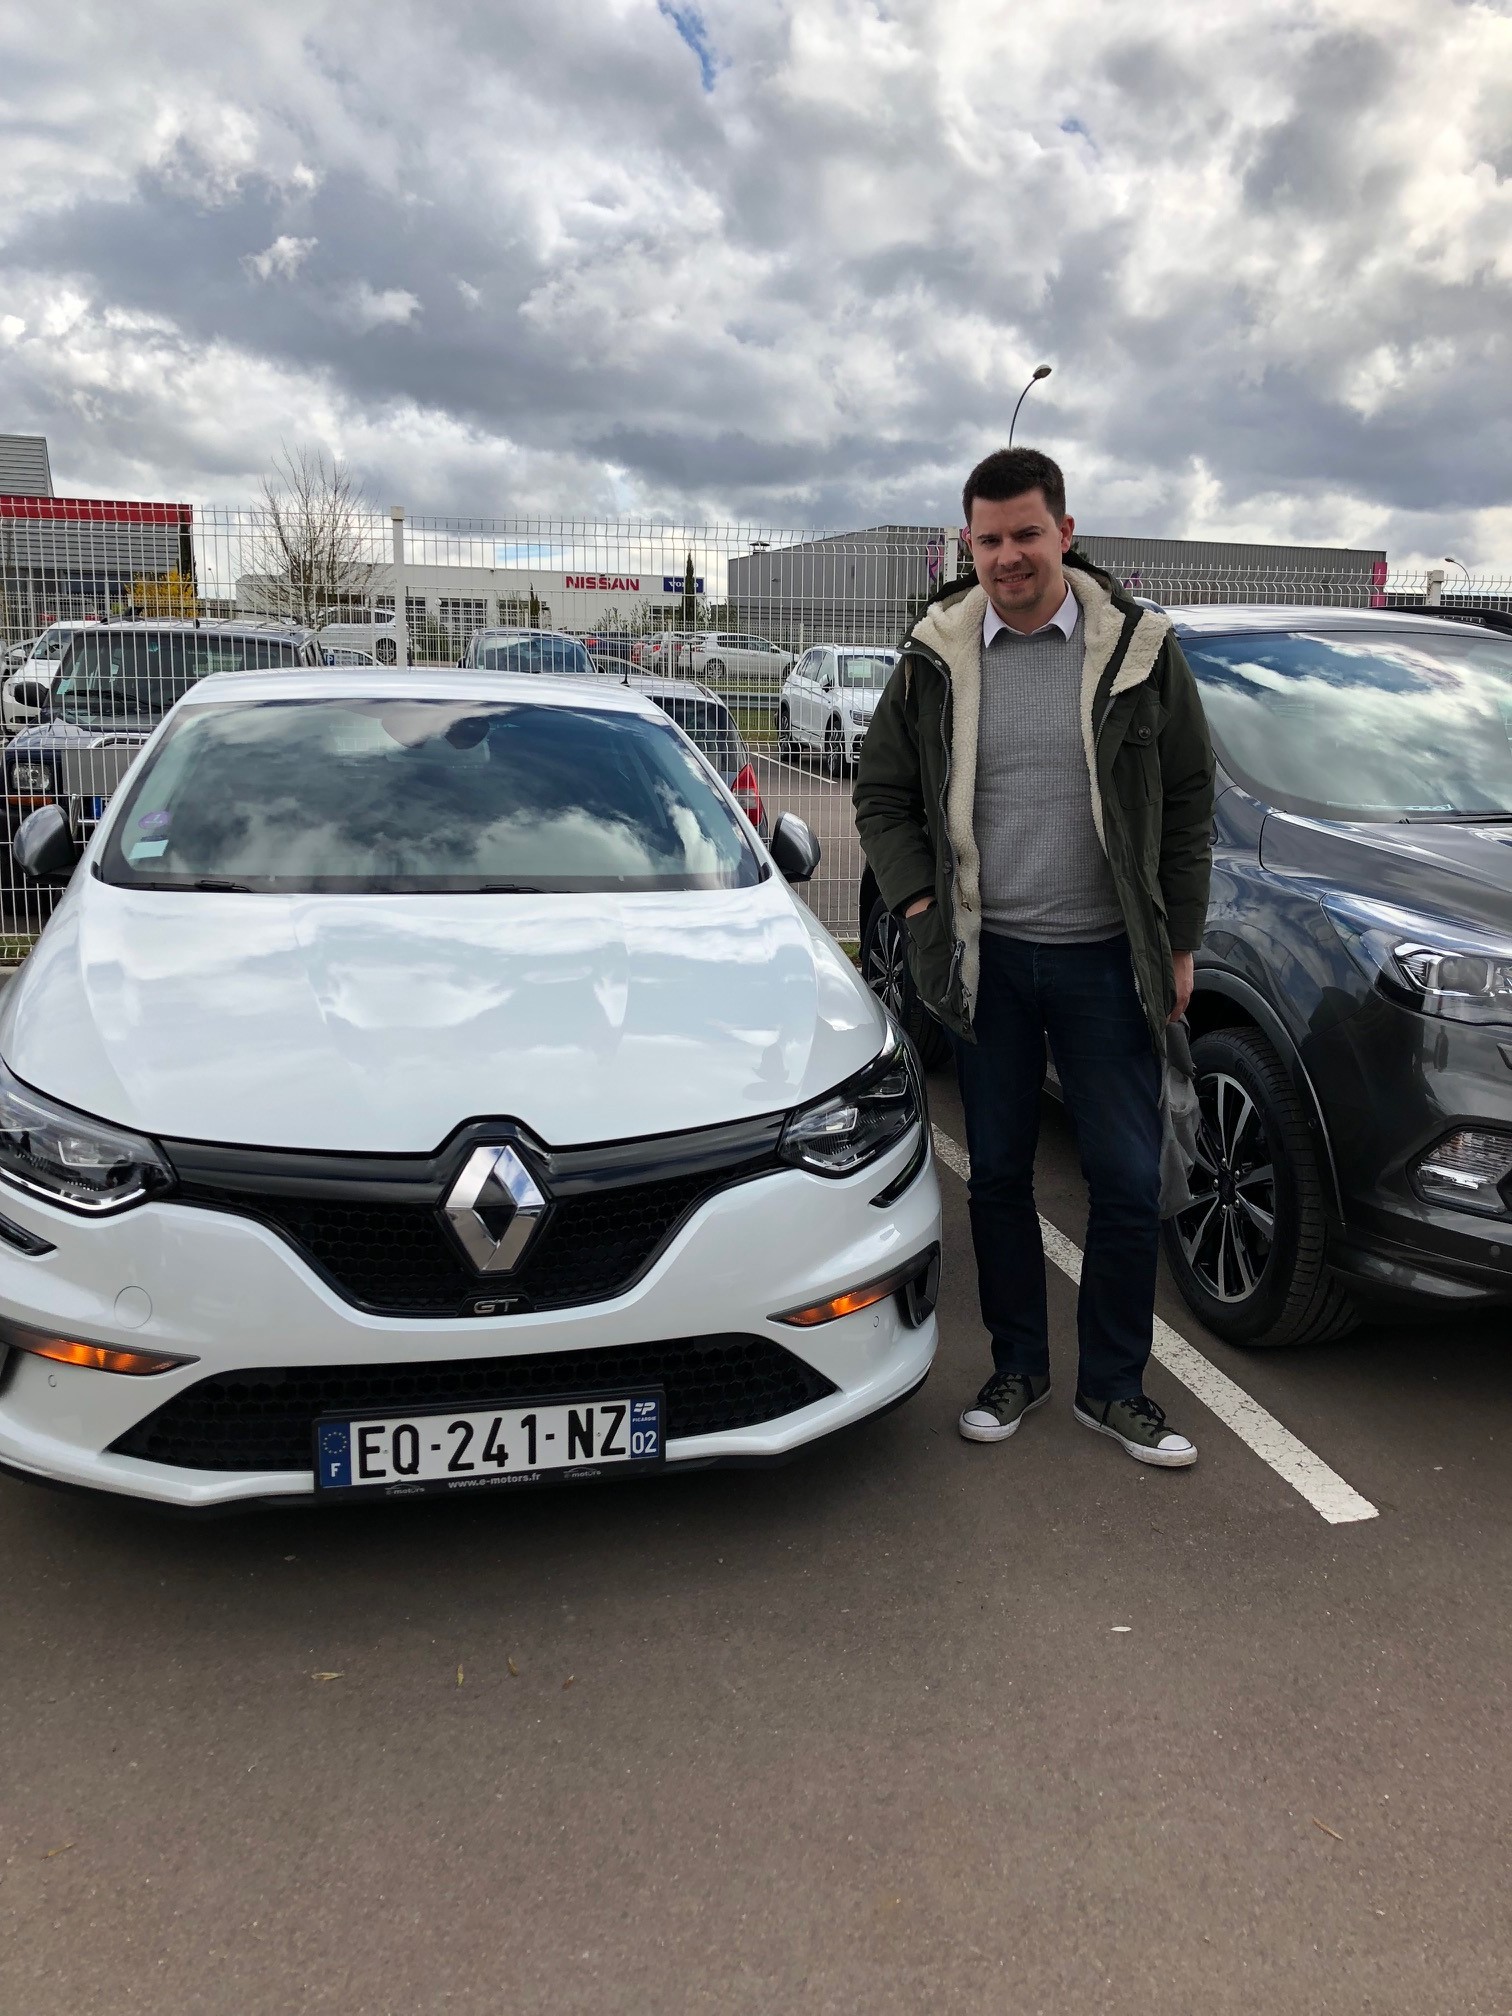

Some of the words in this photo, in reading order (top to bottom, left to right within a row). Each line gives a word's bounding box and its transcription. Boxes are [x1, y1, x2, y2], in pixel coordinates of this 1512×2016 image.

[565, 576, 640, 591] NISSAN
[474, 1298, 518, 1314] GT
[358, 1404, 627, 1479] EQ-241-NZ
[632, 1430, 657, 1454] 02
[331, 1462, 341, 1477] F
[448, 1472, 542, 1489] www.e-motors.fr
